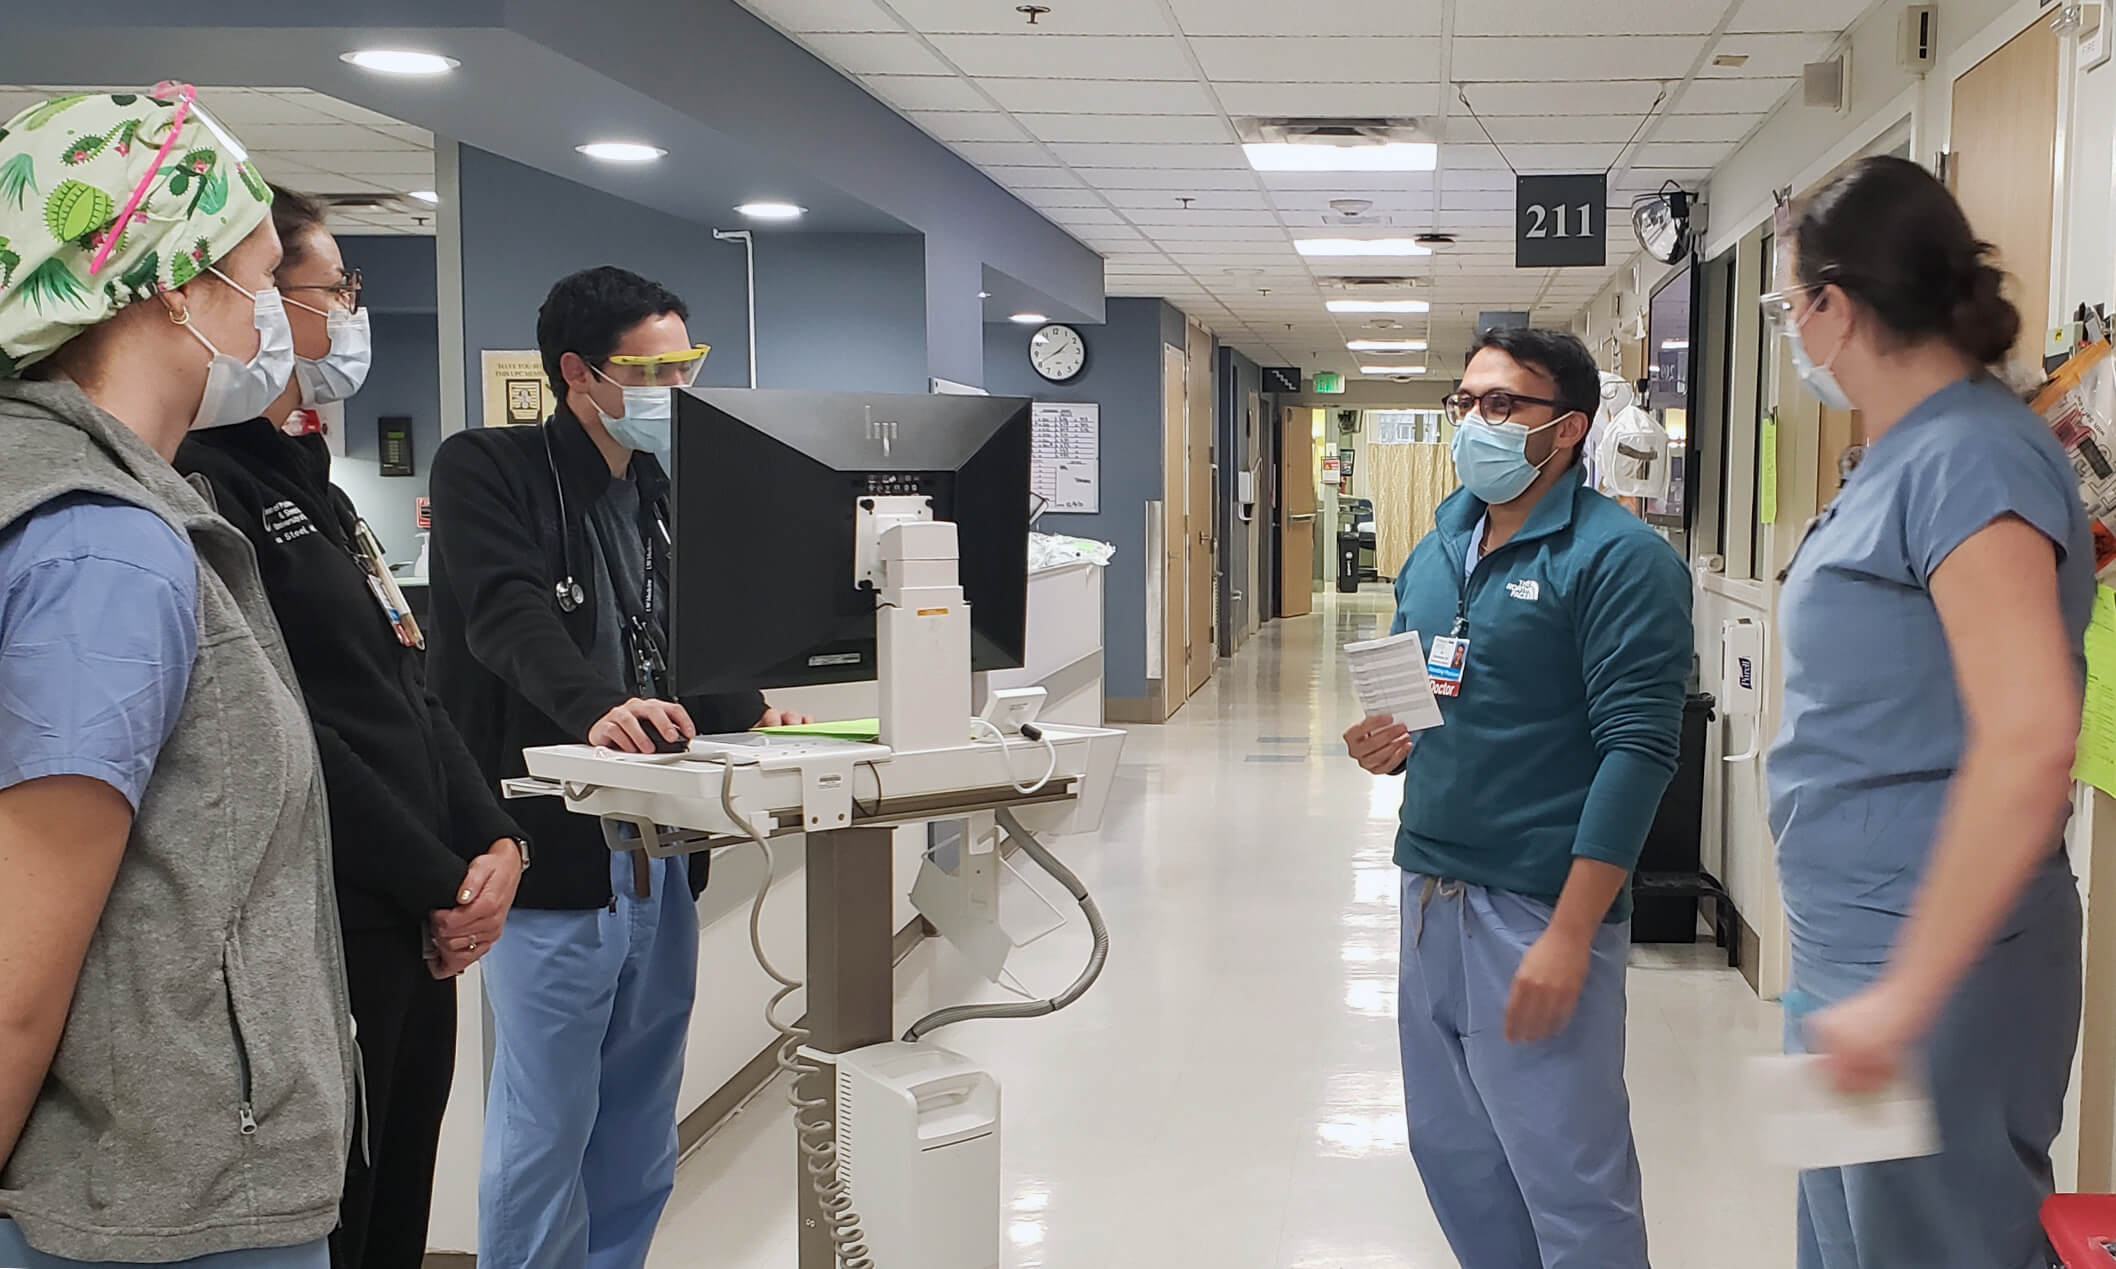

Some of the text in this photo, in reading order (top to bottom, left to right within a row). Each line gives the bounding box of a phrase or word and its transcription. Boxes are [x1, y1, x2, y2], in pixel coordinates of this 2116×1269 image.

[1526, 203, 1594, 238] 211
[1057, 369, 1063, 377] 6
[1429, 680, 1456, 696] Doctor
